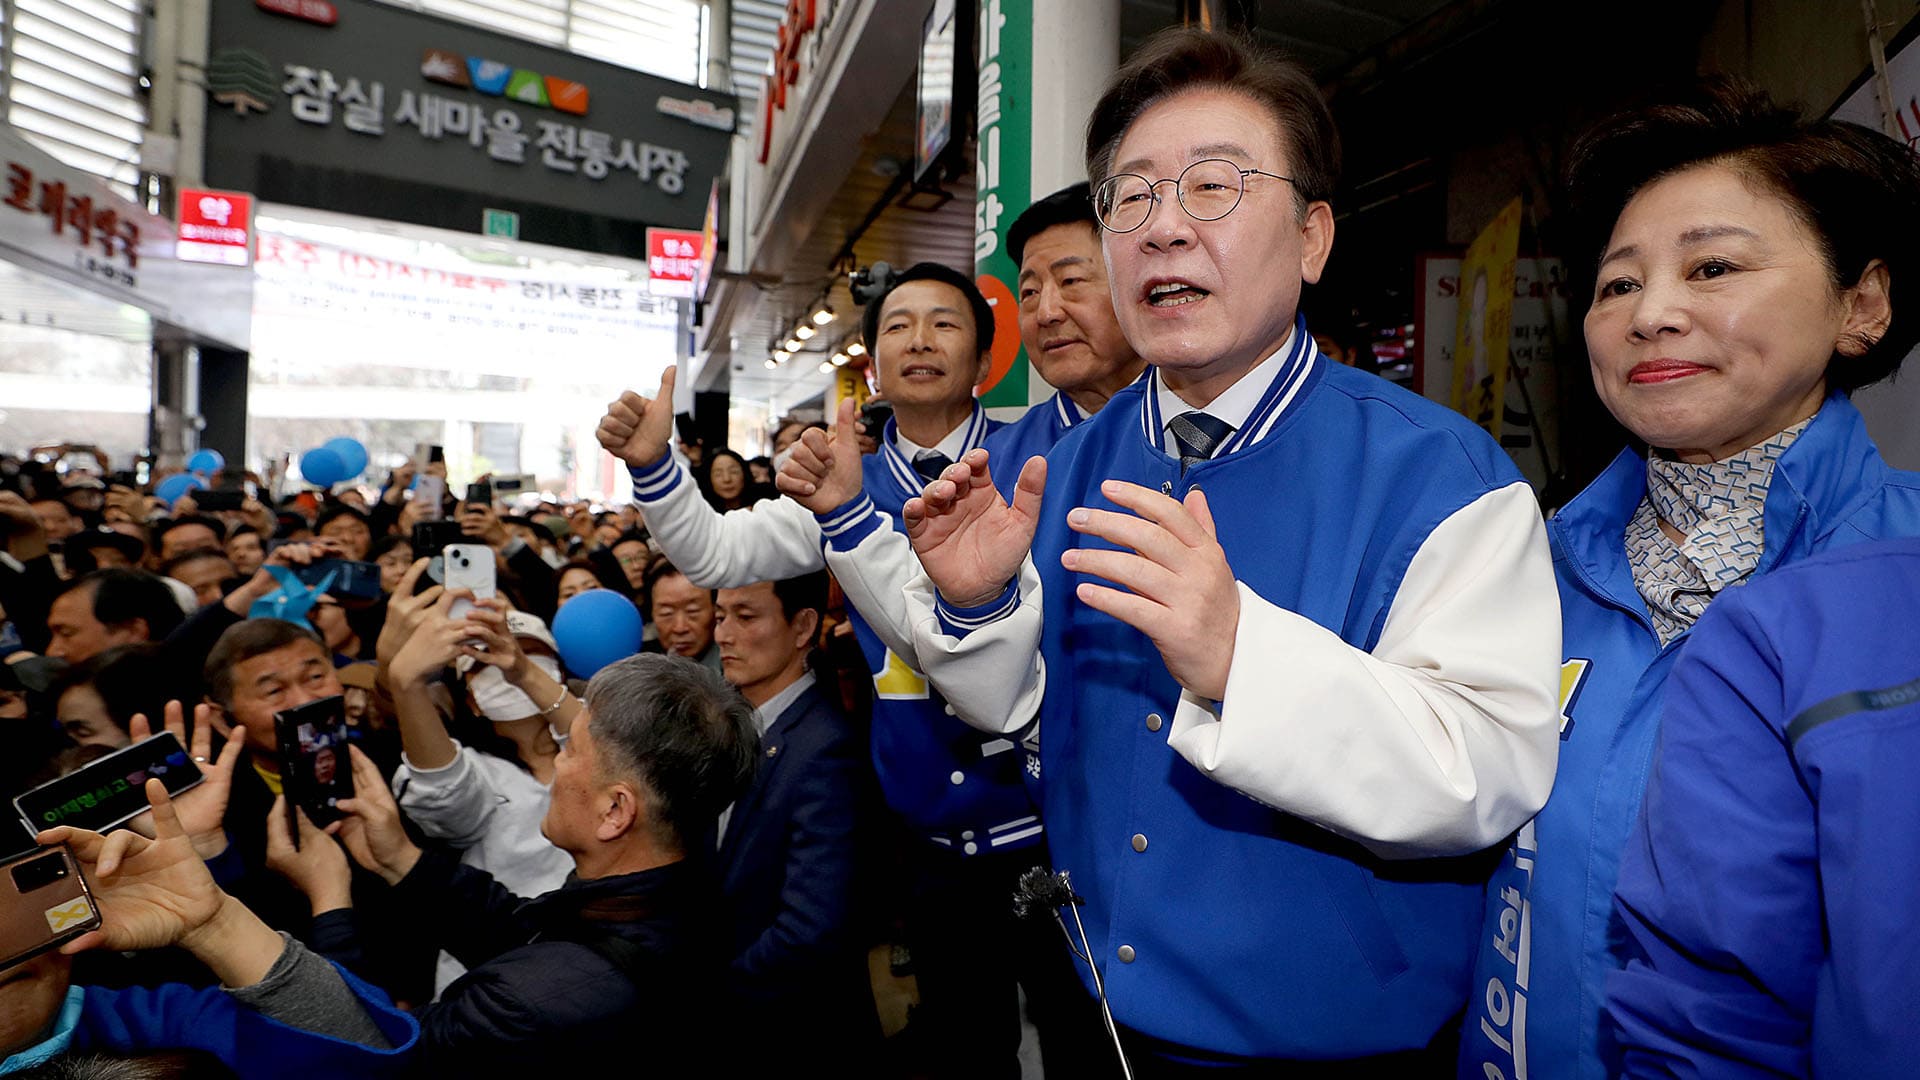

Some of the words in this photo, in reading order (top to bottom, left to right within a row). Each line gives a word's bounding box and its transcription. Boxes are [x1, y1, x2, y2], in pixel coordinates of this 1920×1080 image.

[282, 63, 385, 136] 잠실
[394, 89, 528, 164] 새마을
[536, 119, 690, 195] 전통시장
